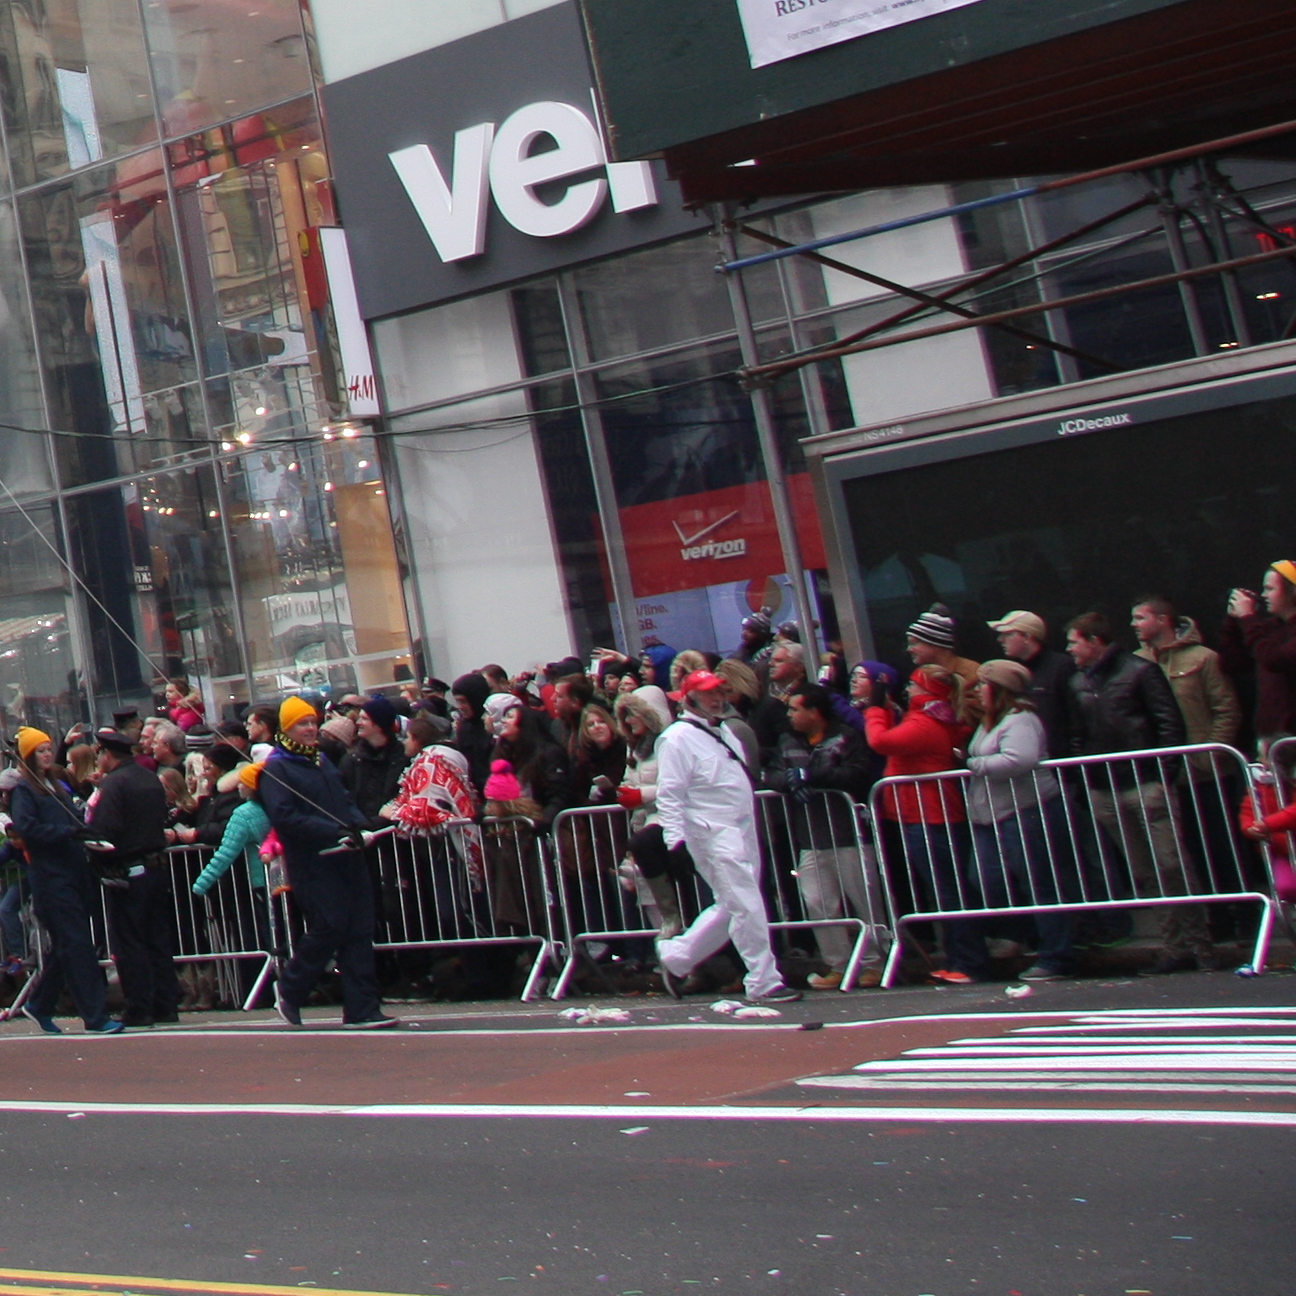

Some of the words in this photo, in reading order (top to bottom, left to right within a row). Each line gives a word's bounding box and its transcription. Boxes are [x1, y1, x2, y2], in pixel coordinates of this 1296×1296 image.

[348, 375, 374, 401] H&M
[1057, 411, 1132, 436] JCDecaux
[681, 538, 746, 561] verizon
